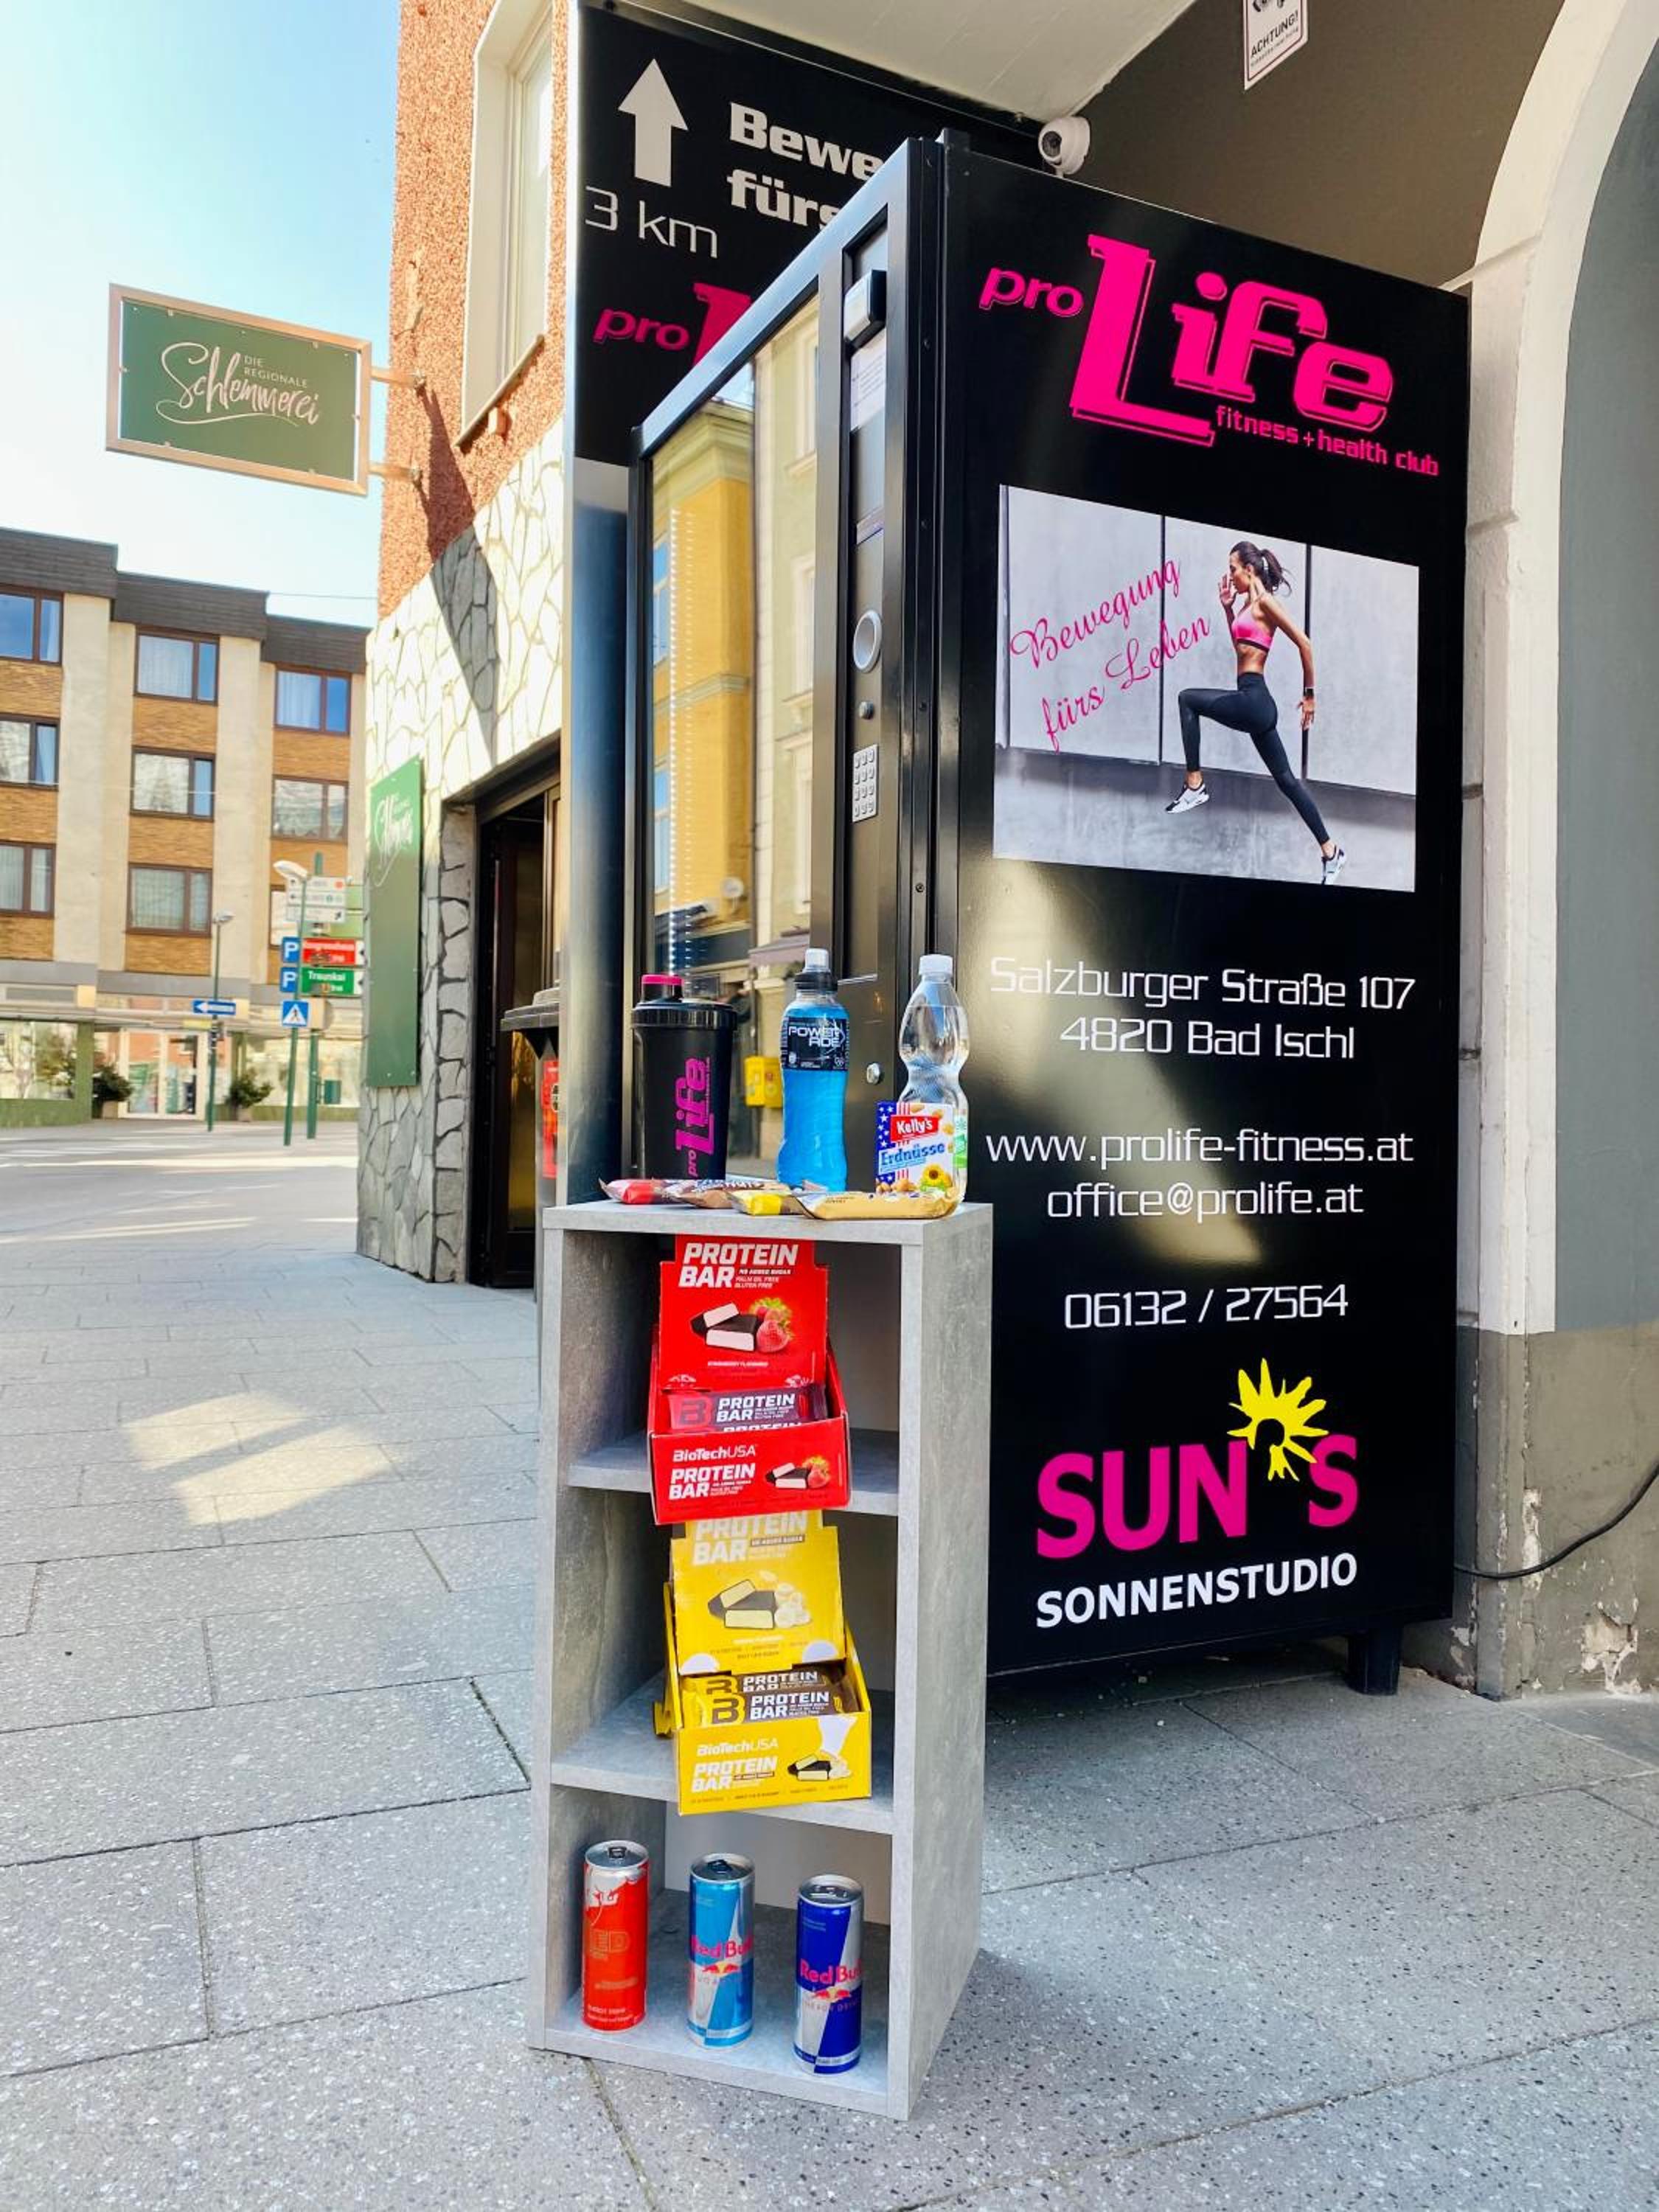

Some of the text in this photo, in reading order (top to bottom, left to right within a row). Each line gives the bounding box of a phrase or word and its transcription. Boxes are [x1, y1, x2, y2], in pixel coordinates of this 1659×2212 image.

[1251, 10, 1298, 58] ACHTUNG!
[585, 186, 718, 259] 3 km
[594, 308, 689, 352] pro
[979, 234, 1394, 448] pro Life
[244, 355, 264, 368] DIE
[156, 341, 322, 427] Schlemmerei
[244, 367, 308, 389] REGIONALE
[1395, 448, 1440, 476] club
[1010, 560, 1180, 669] Bewegung
[1042, 617, 1211, 755] fürs Leben
[990, 957, 1416, 1010] Salzburger Straße 107
[1060, 1017, 1355, 1059] 4820 Bad Ischl
[896, 1117, 933, 1135] Kelly's
[881, 1143, 945, 1166] Erdnüsse
[986, 1128, 1414, 1170] www.prolife-fitness.at
[1048, 1182, 1365, 1224] office@prolife.at
[683, 1242, 799, 1266] PROTEIN
[678, 1265, 735, 1288] BAR
[1065, 1290, 1187, 1329] 06132
[1225, 1284, 1349, 1322] 27564
[719, 1393, 796, 1410] PROTEIN
[716, 1409, 753, 1422] BAR
[671, 1463, 756, 1484] PROTEIN
[669, 1483, 709, 1500] BAR
[695, 1510, 807, 1541] PROTEIN
[692, 1540, 747, 1565] BAR
[1036, 1553, 1358, 1629] SONNENSTUDIO
[743, 1672, 818, 1686] PROTEIN
[751, 1691, 830, 1707] PROTEIN
[750, 1705, 788, 1720] BAR
[693, 1755, 779, 1778] PROTEIN
[692, 1775, 732, 1793] BAR
[800, 1958, 834, 1984] Red
